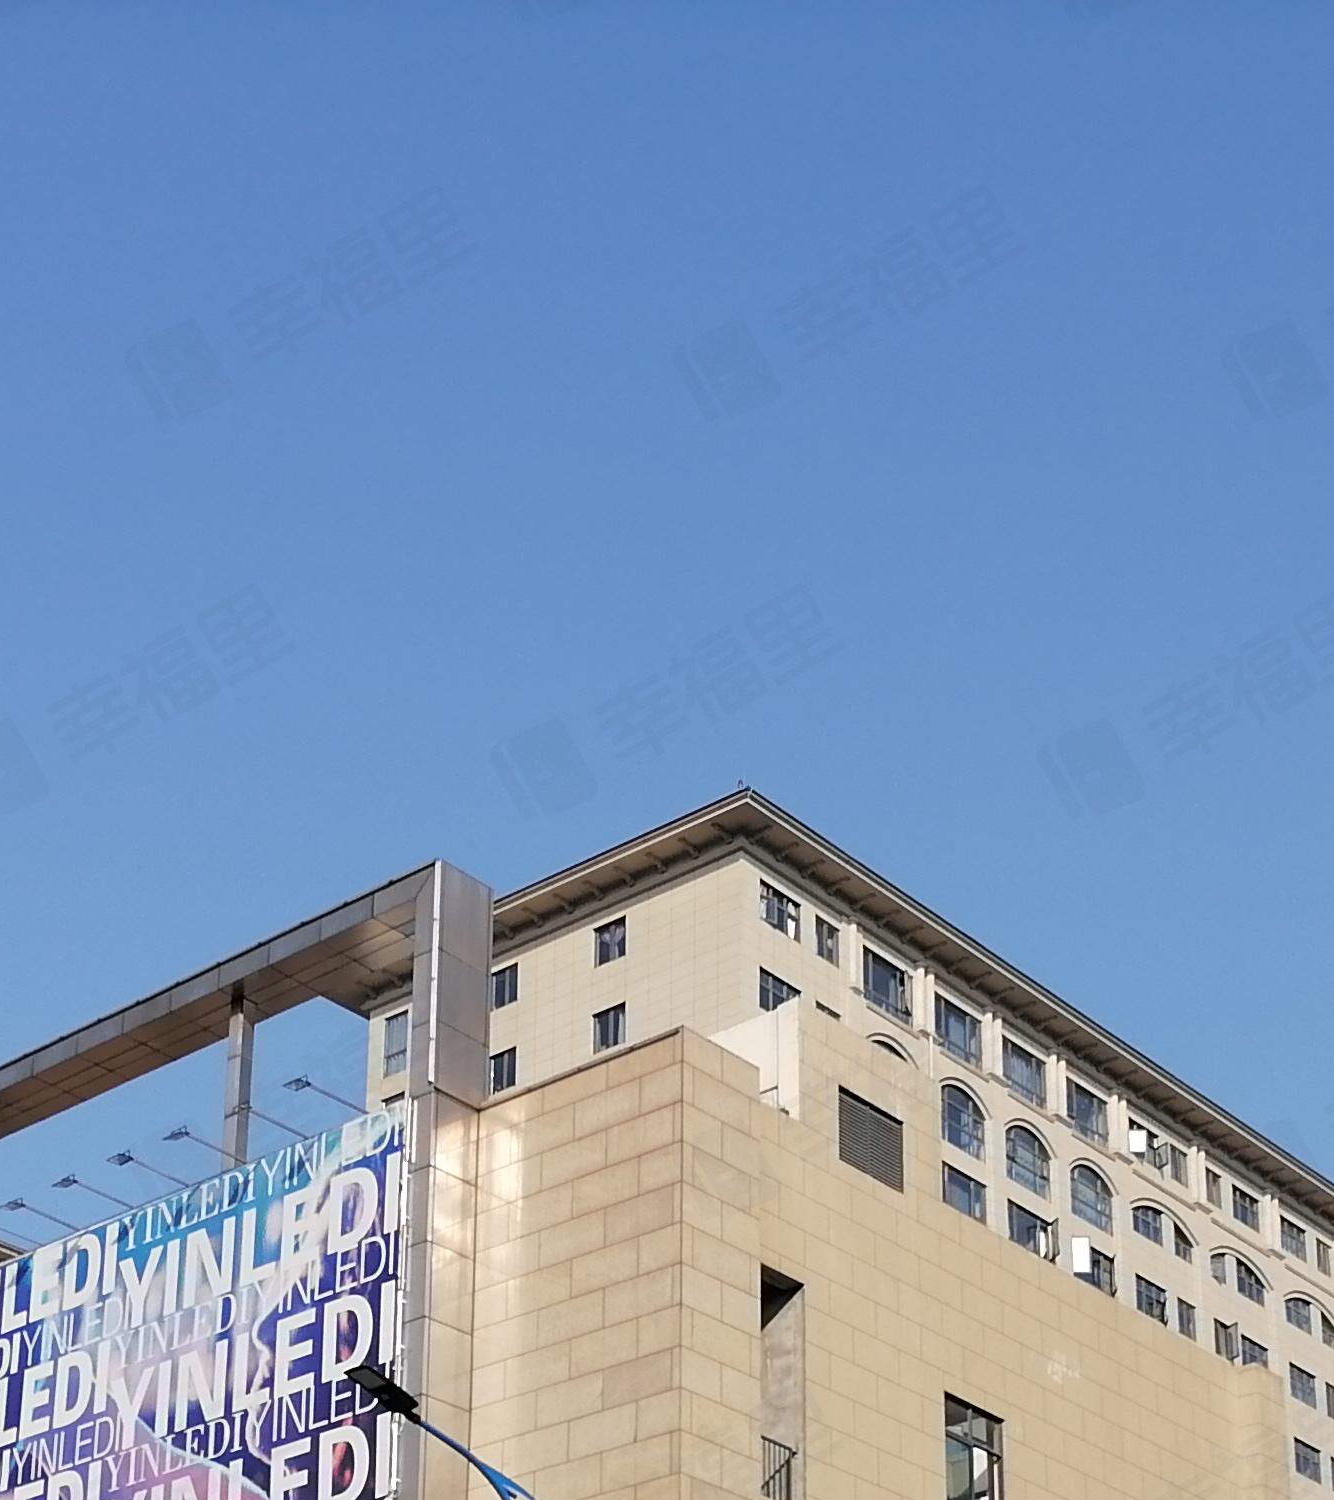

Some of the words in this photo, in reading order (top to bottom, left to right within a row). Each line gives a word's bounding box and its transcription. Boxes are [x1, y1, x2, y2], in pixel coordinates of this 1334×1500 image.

[120, 1154, 400, 1328] YINLEDI
[122, 1164, 257, 1250] YINLEDI
[254, 1237, 397, 1312] YINLEDI
[107, 1281, 394, 1451] YINLEDI
[114, 1293, 251, 1367] YINLEDI
[13, 1414, 124, 1485] YINLEDI
[108, 1419, 241, 1488] YINLEDI
